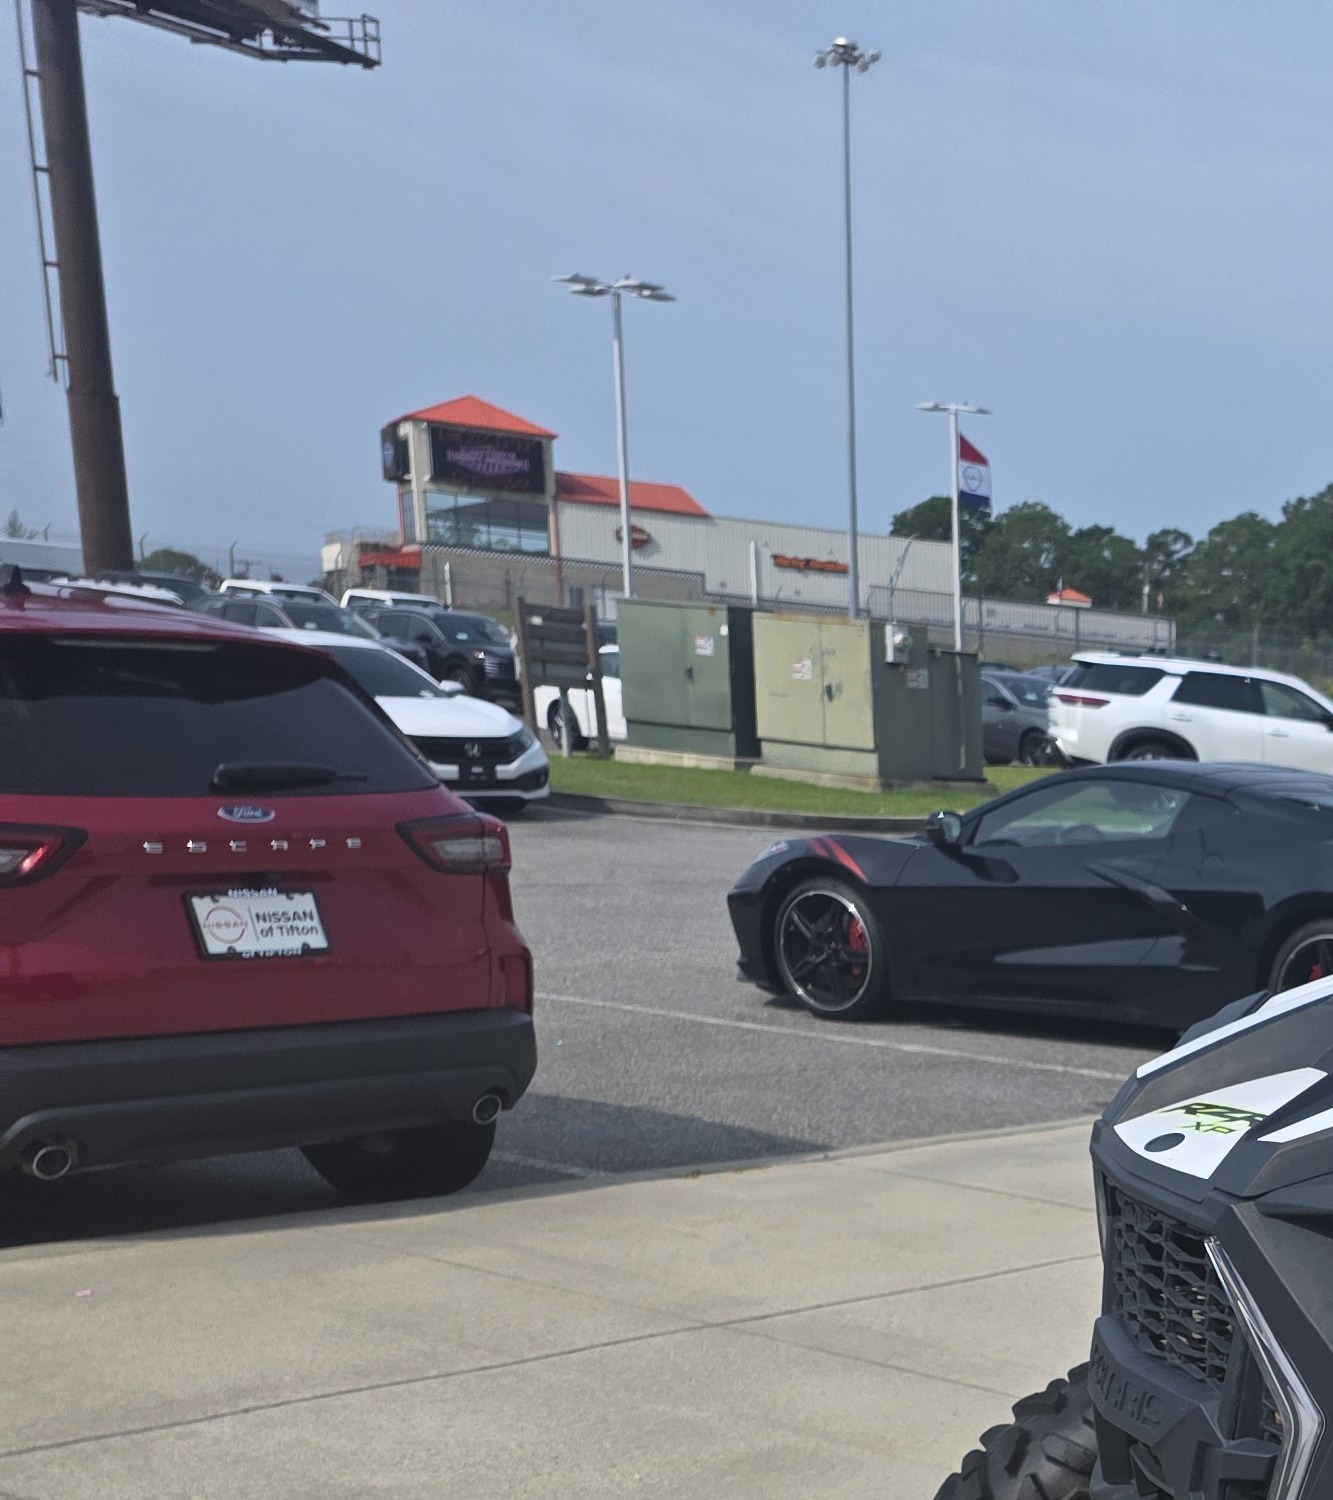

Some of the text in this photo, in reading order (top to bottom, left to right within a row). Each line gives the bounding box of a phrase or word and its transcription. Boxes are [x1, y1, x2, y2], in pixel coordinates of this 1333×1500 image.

[231, 804, 263, 818] Ford
[143, 837, 361, 854] ESCAPE
[255, 909, 315, 925] NISSAN
[277, 923, 319, 938] Tifton
[1157, 1102, 1269, 1128] RZR
[1178, 1121, 1237, 1135] XP
